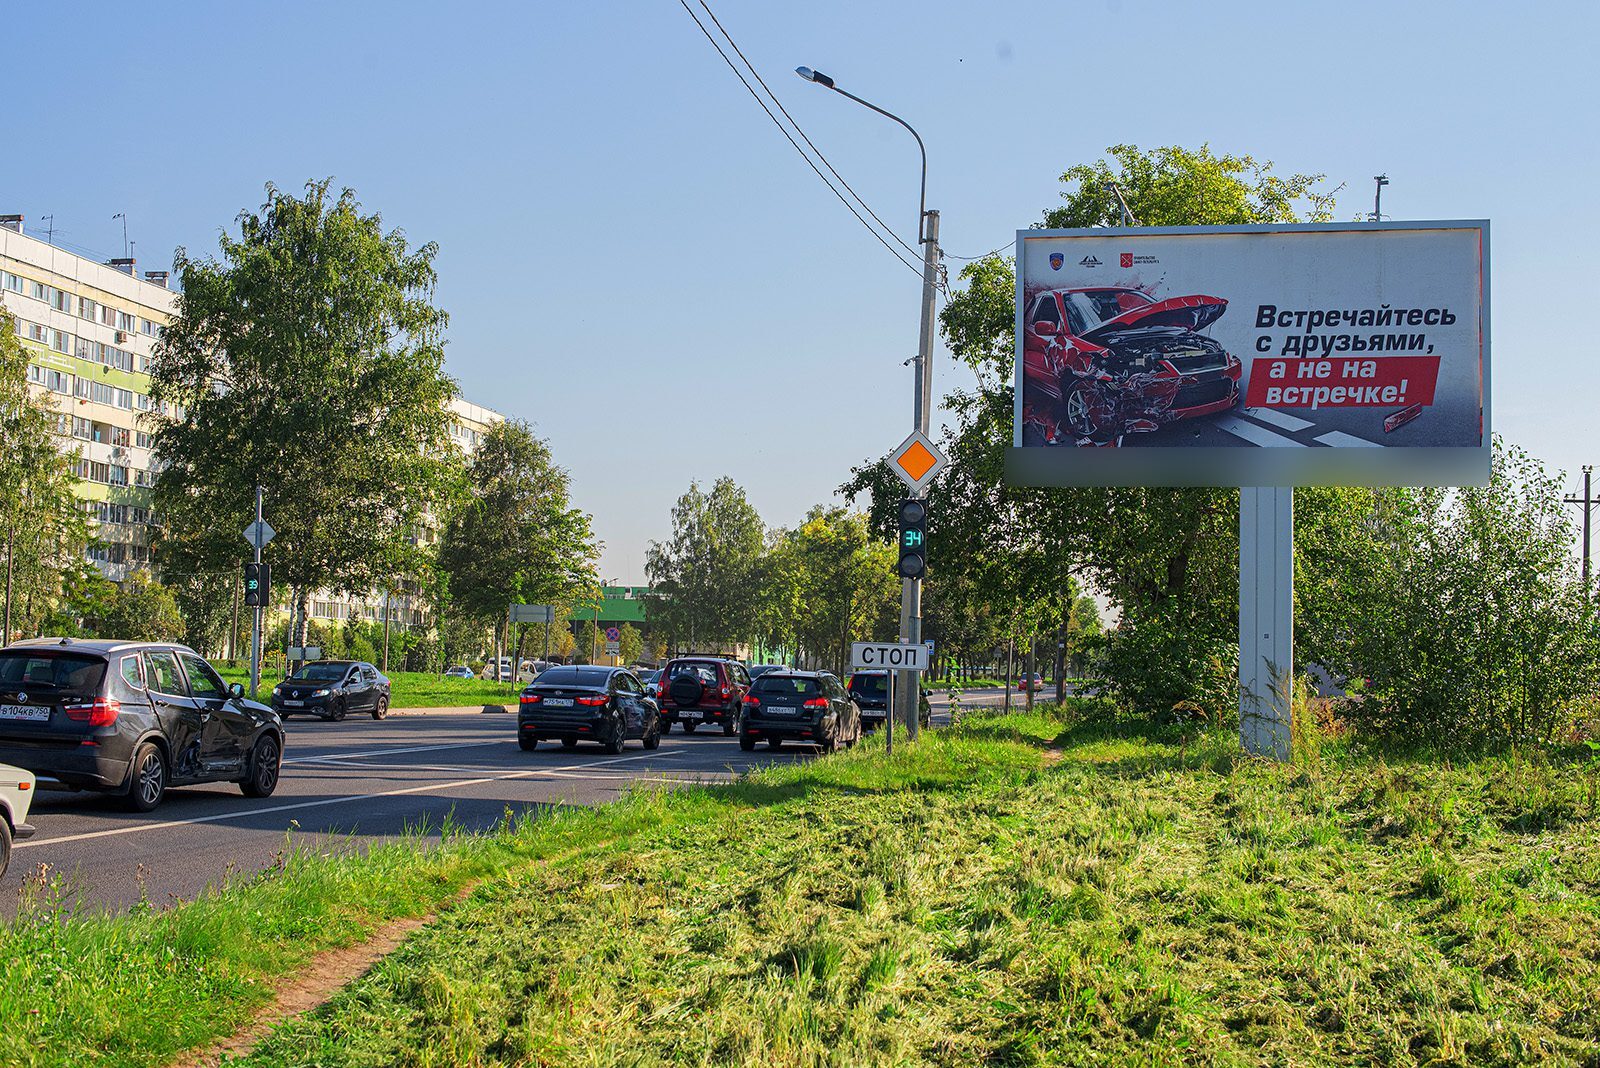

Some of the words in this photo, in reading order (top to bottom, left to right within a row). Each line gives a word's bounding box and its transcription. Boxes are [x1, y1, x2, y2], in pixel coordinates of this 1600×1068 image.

[1255, 304, 1456, 333] Встречайтесь
[1256, 335, 1272, 352] с
[1281, 334, 1434, 358] друзьями,
[1269, 361, 1286, 378] а
[1297, 361, 1331, 378] не
[1342, 360, 1376, 378] на
[1266, 379, 1408, 410] встречке!
[905, 531, 921, 546] 34
[862, 647, 917, 666] СТОП
